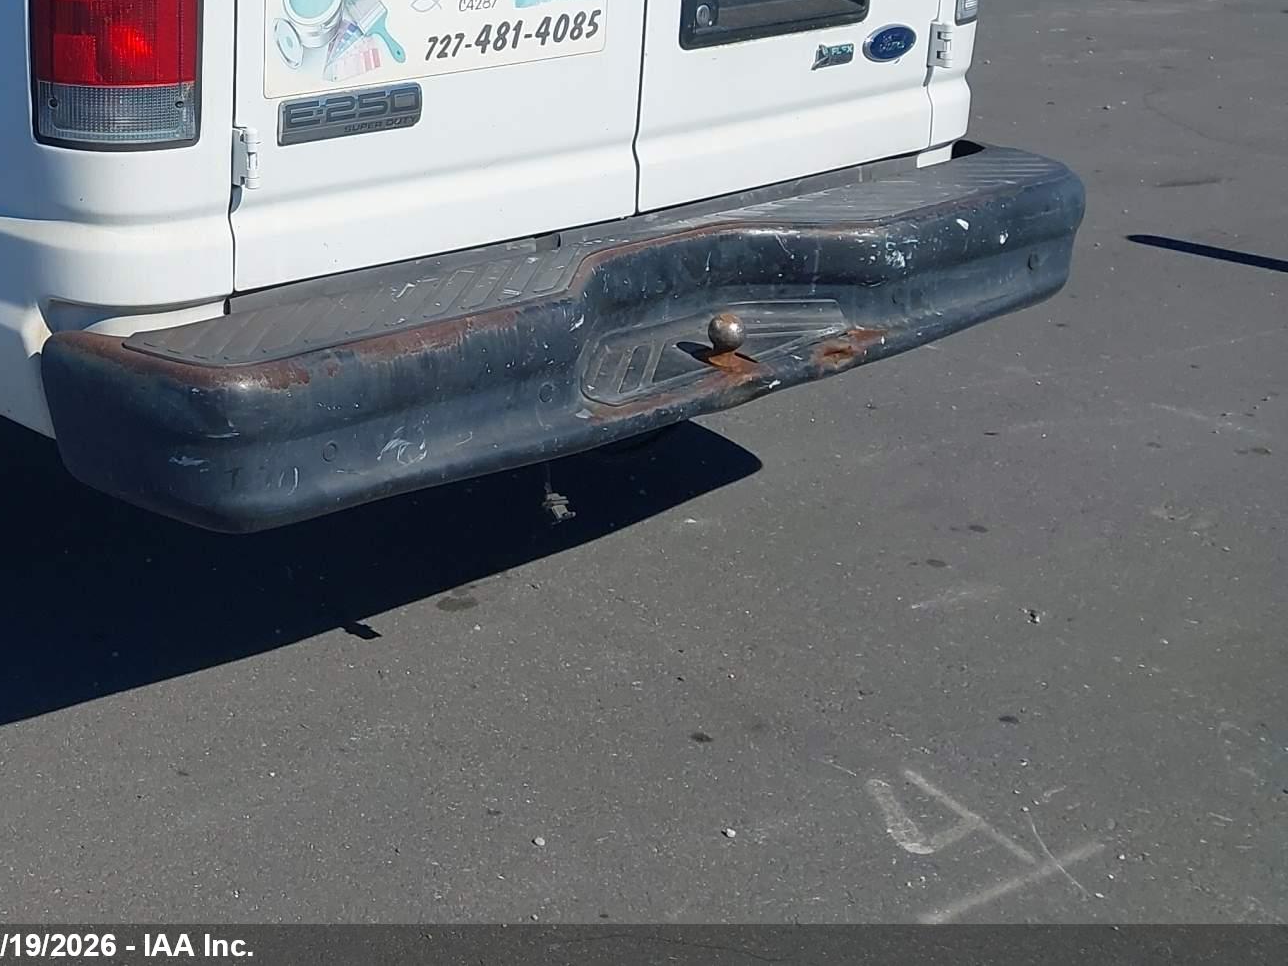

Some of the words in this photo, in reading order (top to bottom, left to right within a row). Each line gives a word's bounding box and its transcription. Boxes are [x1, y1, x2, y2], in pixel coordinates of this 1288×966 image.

[425, 9, 602, 61] 727-481-4085
[284, 86, 420, 129] E-250
[344, 119, 383, 133] SUPER
